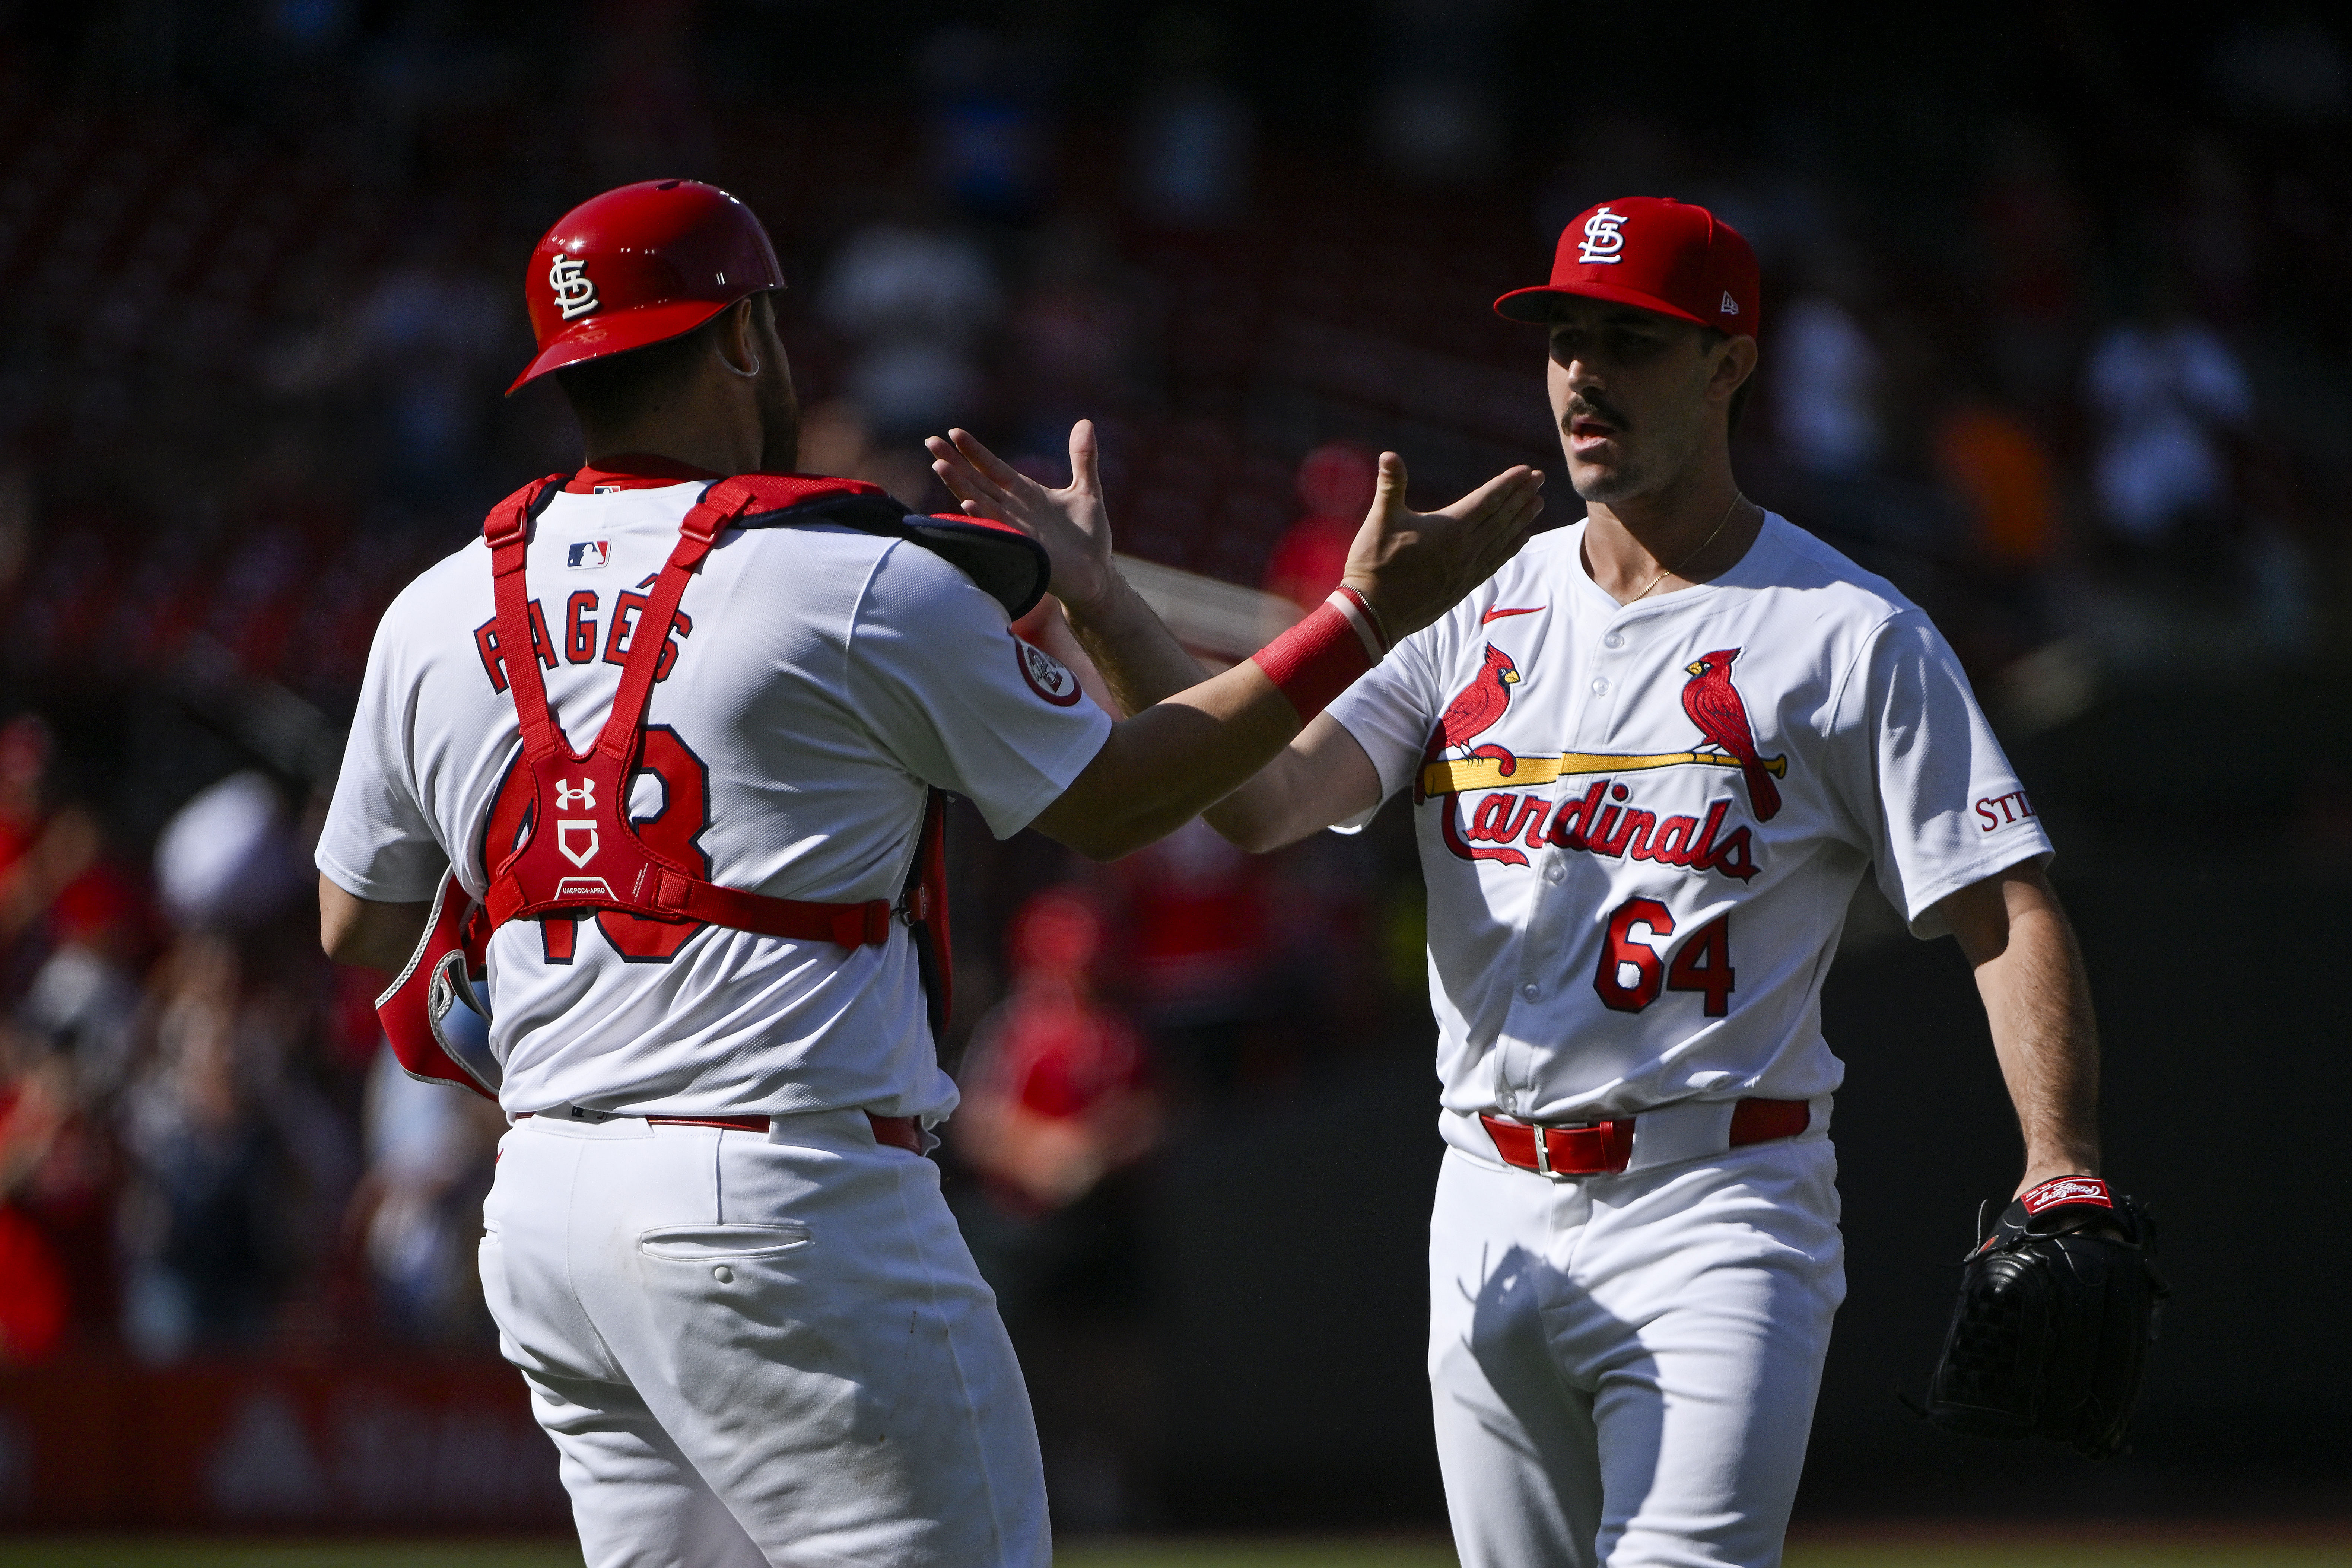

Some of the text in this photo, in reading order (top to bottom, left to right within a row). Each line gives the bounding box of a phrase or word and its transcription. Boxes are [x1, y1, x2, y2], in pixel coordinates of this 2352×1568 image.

[1441, 744, 1761, 885] Cardinals
[1592, 897, 1735, 1018] 64
[2034, 1183, 2101, 1206] Rawlings
